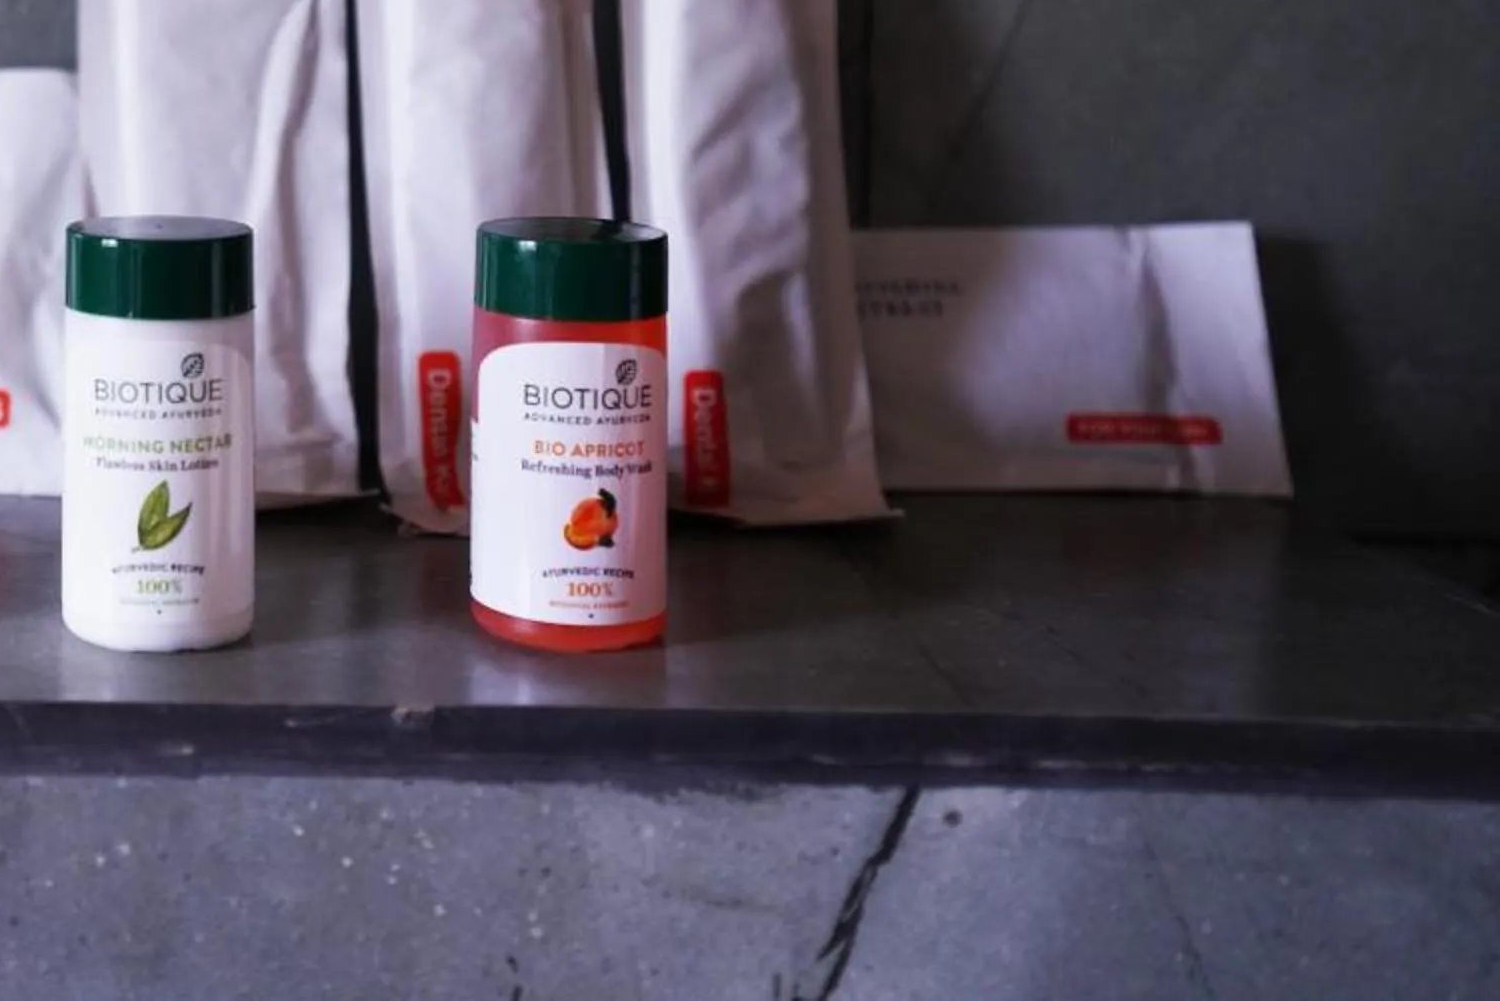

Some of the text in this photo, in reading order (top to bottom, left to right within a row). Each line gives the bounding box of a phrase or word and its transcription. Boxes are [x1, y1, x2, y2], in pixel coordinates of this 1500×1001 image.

[94, 378, 224, 404] BIOTIQUE
[523, 383, 652, 411] BIOTIQUE
[523, 412, 592, 425] ADVANCED
[83, 432, 233, 454] MORNING NECTAR
[533, 439, 645, 458] BIO APRICOT
[148, 458, 179, 472] Skin
[521, 458, 593, 479] Refreshing
[595, 463, 624, 479] Body
[137, 578, 183, 594] 100%
[568, 581, 614, 597] 100%
